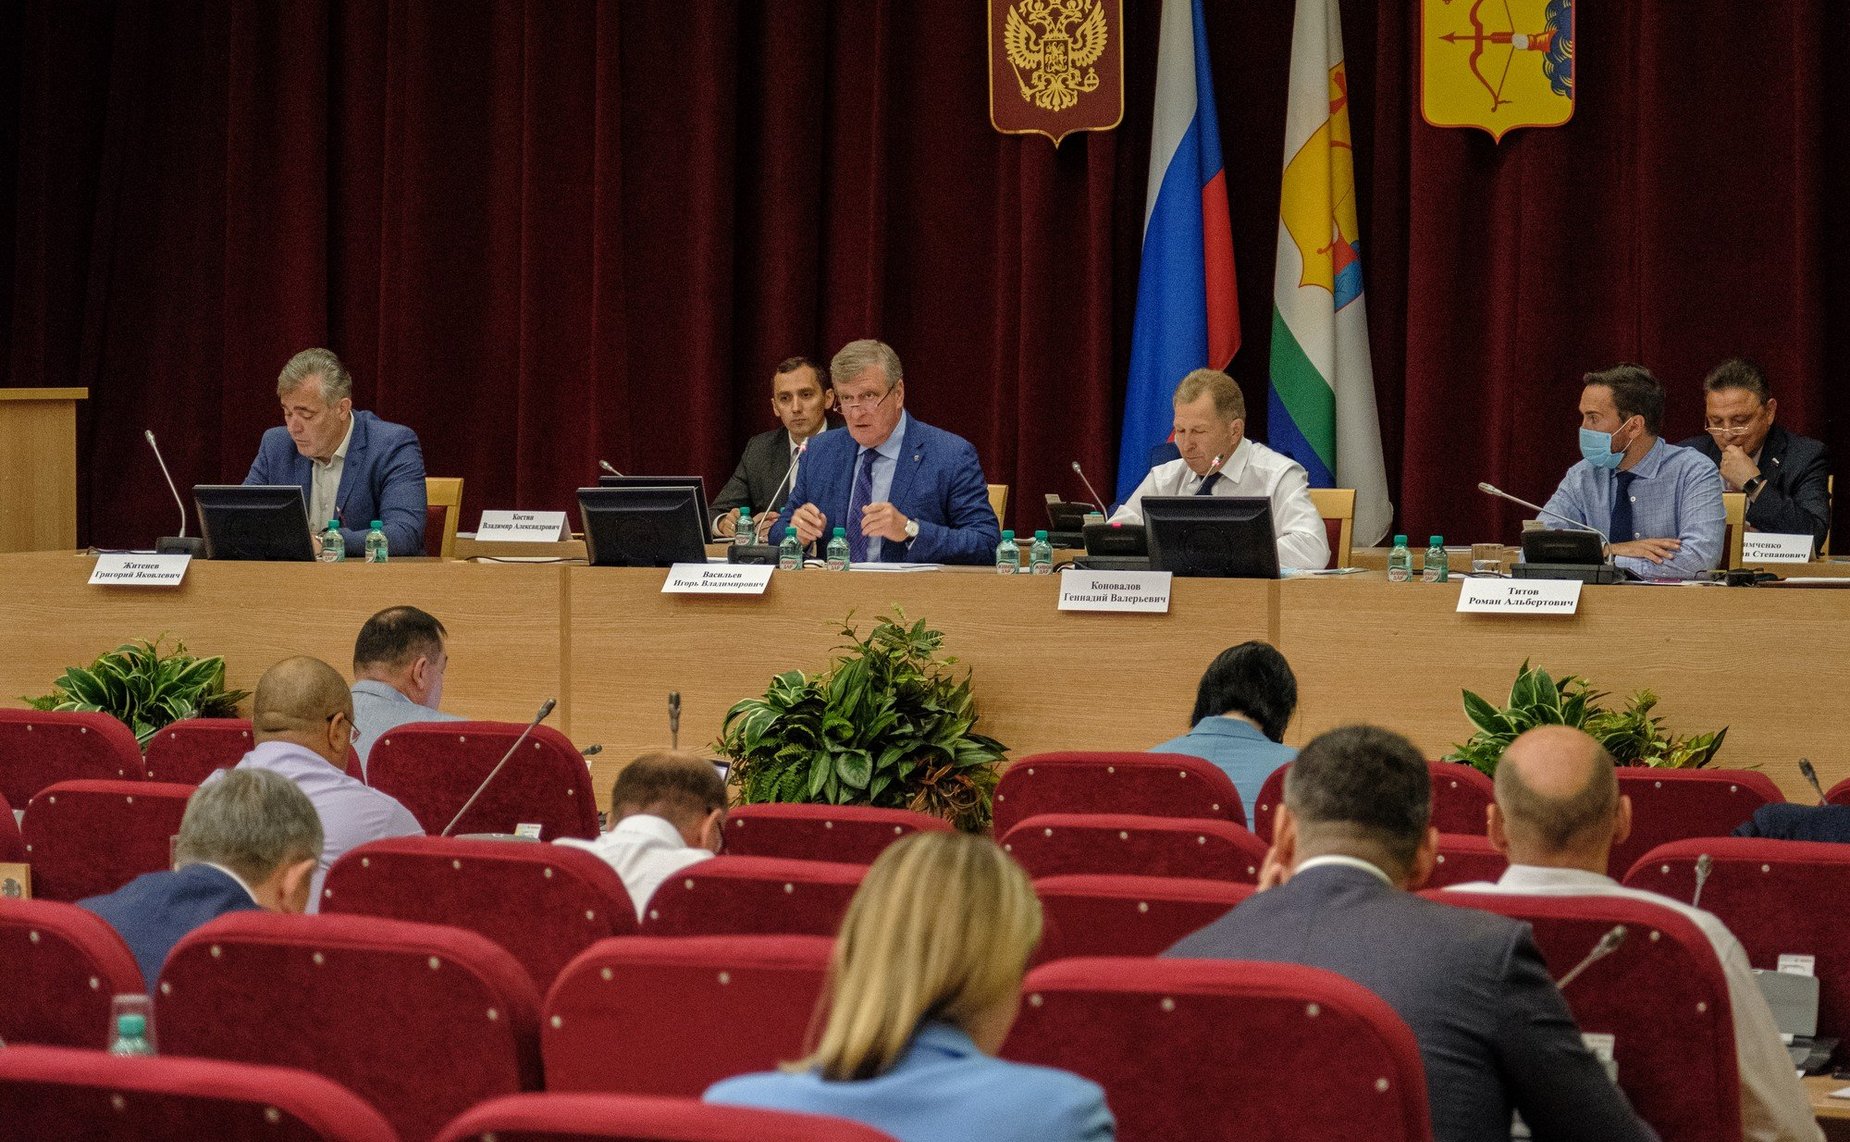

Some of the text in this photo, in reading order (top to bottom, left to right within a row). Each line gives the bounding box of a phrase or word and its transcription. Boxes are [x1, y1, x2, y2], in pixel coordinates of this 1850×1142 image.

[482, 522, 560, 531] Владимир Александрович
[1752, 550, 1806, 558] Степанович
[95, 571, 134, 579] Григорий
[673, 580, 764, 588] Игорь Владимирович
[1091, 581, 1141, 591] Коновалов
[1508, 587, 1539, 595] Титов
[1064, 592, 1166, 604] Геннадий Валерьевич
[1469, 597, 1574, 607] Роман Альбертович
